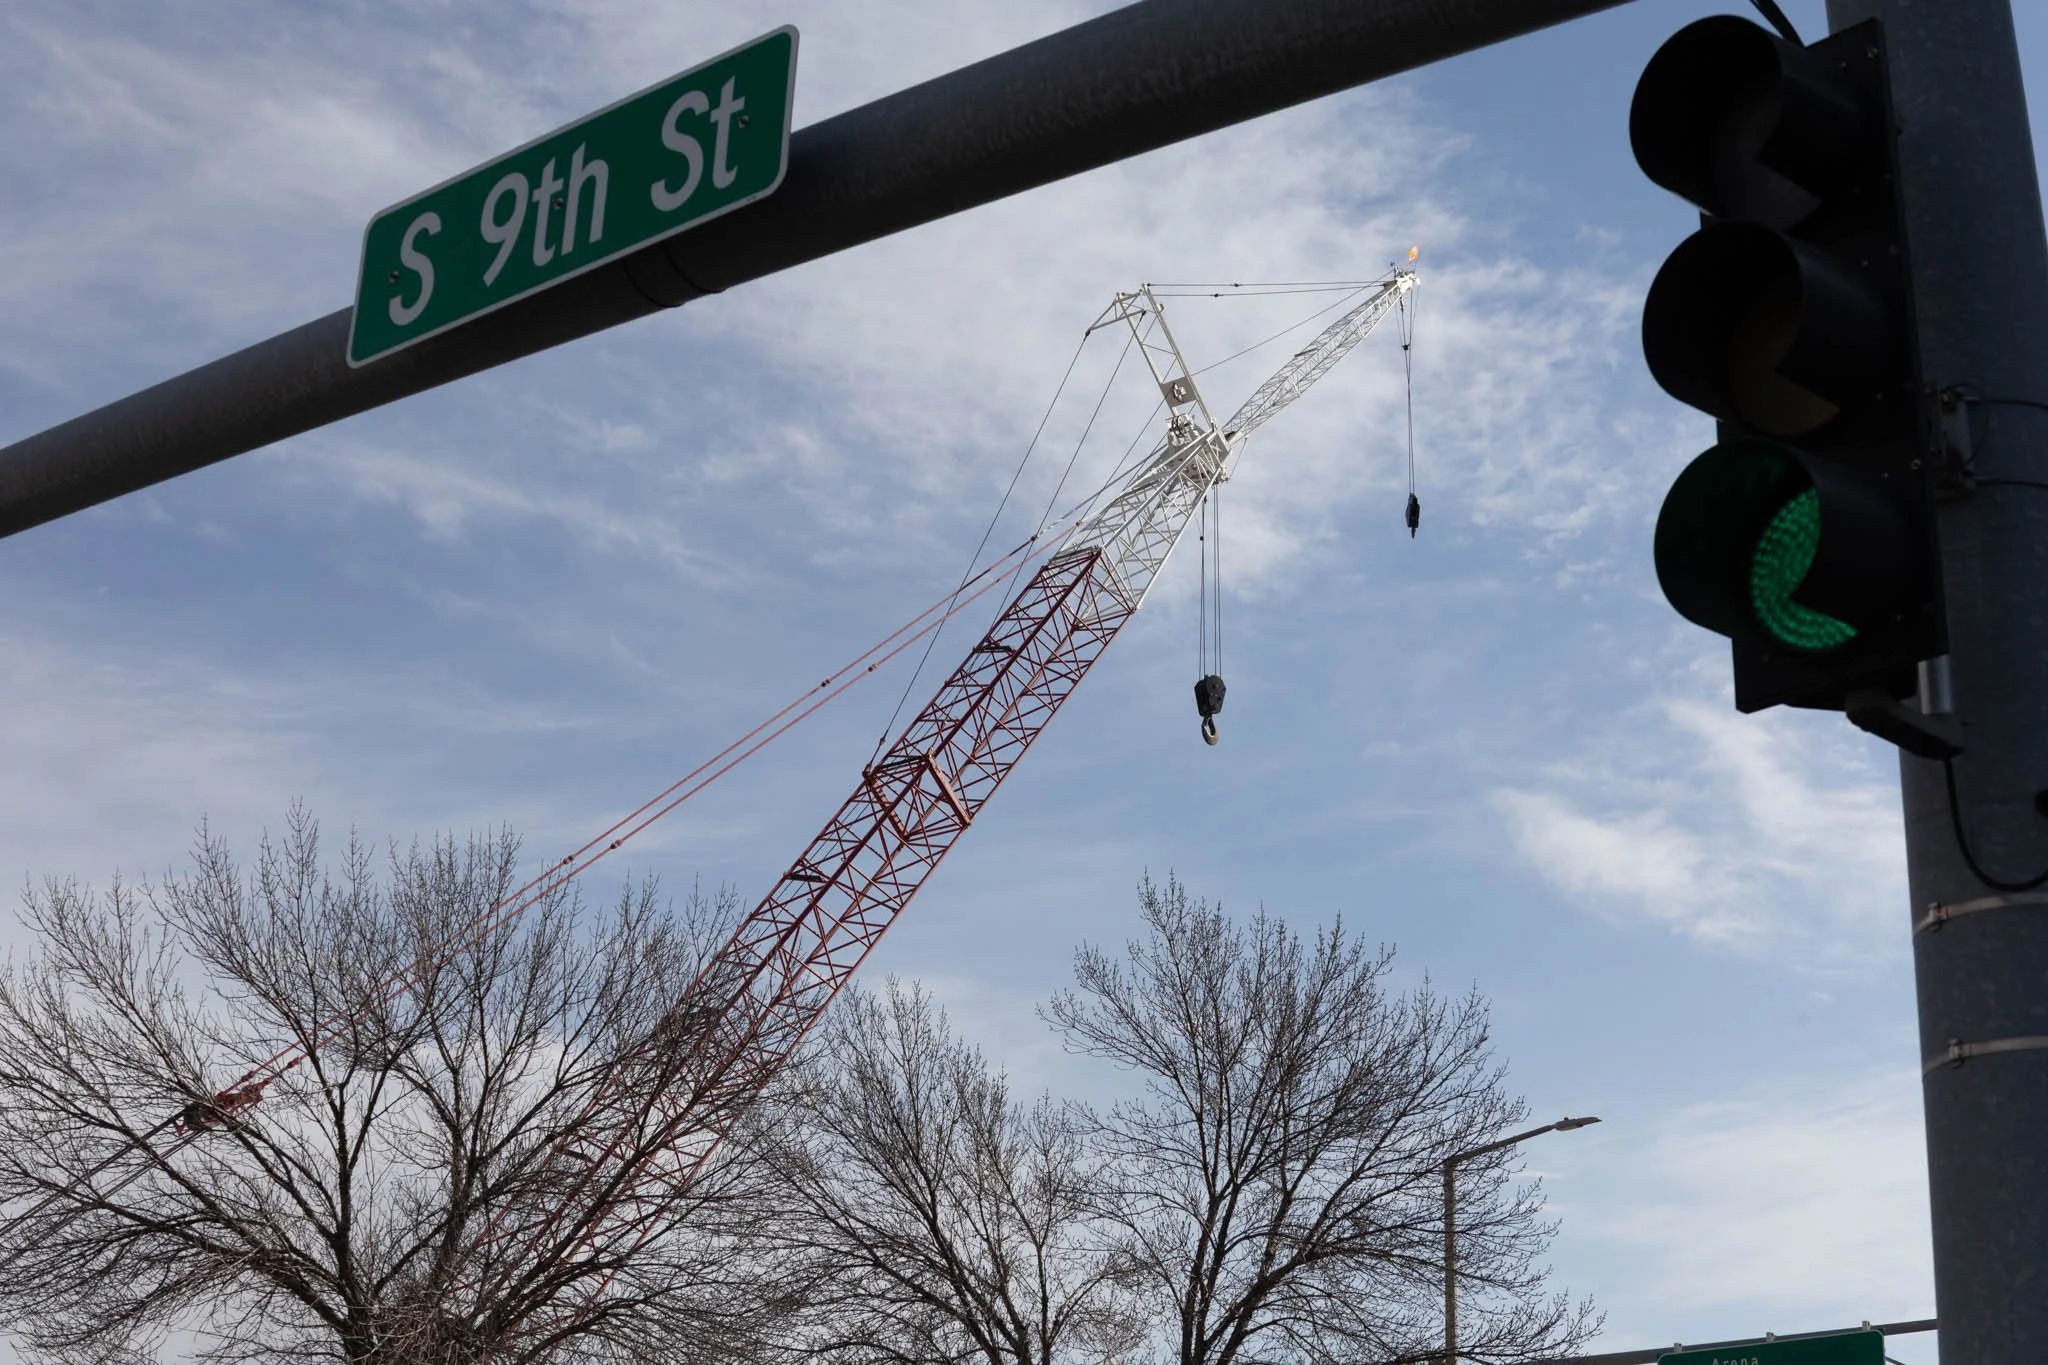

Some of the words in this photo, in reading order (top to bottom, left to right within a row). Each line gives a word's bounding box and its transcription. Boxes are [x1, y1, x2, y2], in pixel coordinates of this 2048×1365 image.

[389, 211, 442, 325] S
[480, 142, 609, 287] 9th
[650, 76, 745, 212] St
